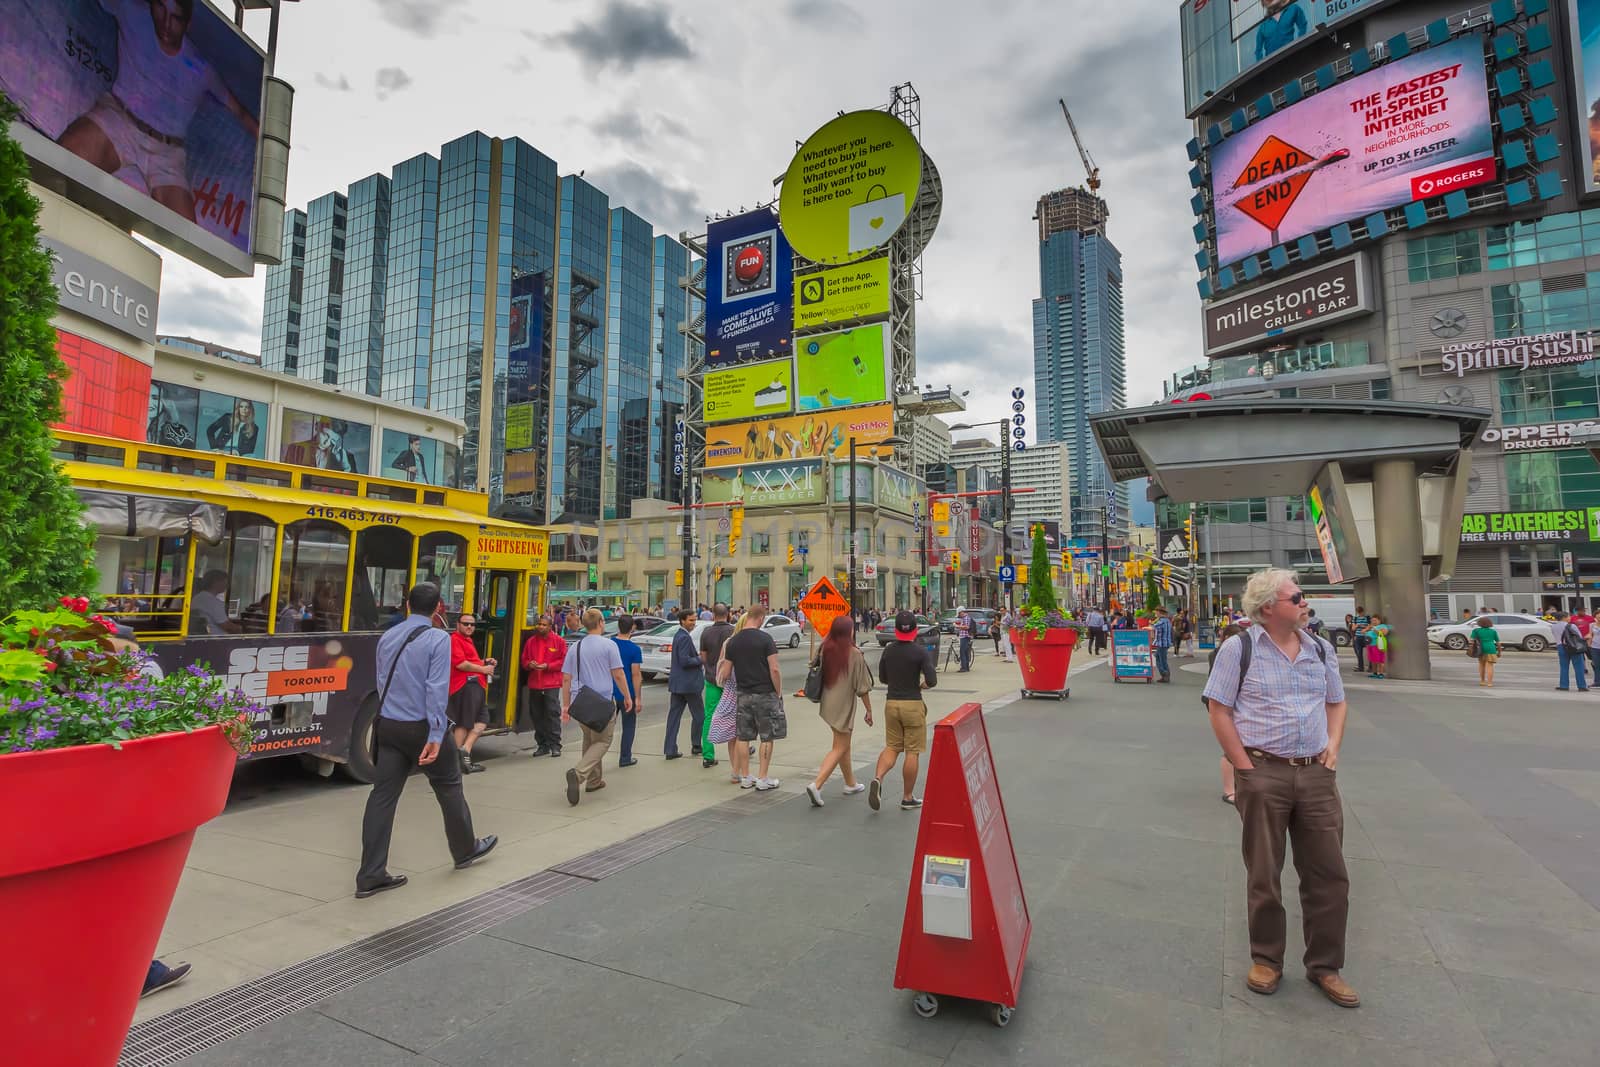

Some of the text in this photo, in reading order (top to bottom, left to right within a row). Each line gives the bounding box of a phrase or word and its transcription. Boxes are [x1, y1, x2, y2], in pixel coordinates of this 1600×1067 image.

[1350, 64, 1462, 113] THE FASTEST
[1366, 86, 1444, 122] HI-SPEED
[1364, 98, 1449, 137] INTERNET
[1387, 120, 1425, 138] IN MORE
[803, 137, 867, 162] Whatever you
[803, 140, 895, 173] need to buy is here.
[1364, 137, 1459, 172] UP TO 3X FASTER.
[803, 160, 867, 184] Whatever you
[1247, 151, 1298, 184] DEAD
[1436, 168, 1484, 187] ROGERS
[803, 166, 886, 196] really want to buy
[803, 188, 853, 207] is here too.
[1254, 182, 1292, 210] END
[740, 256, 759, 268] FUN
[827, 272, 873, 286] Get the App.
[827, 280, 881, 296] Get there now.
[1216, 276, 1346, 331] milestones
[1264, 297, 1348, 329] GRILL BAR
[722, 314, 739, 325] MAKE
[740, 308, 754, 317] THIS
[723, 307, 773, 333] COME ALIVE
[727, 316, 775, 339] FUNSQUARE.CA
[1441, 331, 1566, 353] LOUNGE RESTAURANT
[1012, 387, 1025, 452] Yonge
[751, 465, 814, 494] XXI
[750, 490, 815, 502] FOREVER
[306, 506, 401, 524] 416.463.7467
[1491, 510, 1586, 532] EATERIES!
[478, 538, 543, 556] SIGHTSEEING
[1461, 530, 1571, 541] FREE WI-FI ON LEVEL 3
[802, 602, 846, 612] CONSTRUCTION
[228, 646, 309, 674] SEE
[284, 675, 335, 687] TORONTO
[309, 723, 323, 732] ST.
